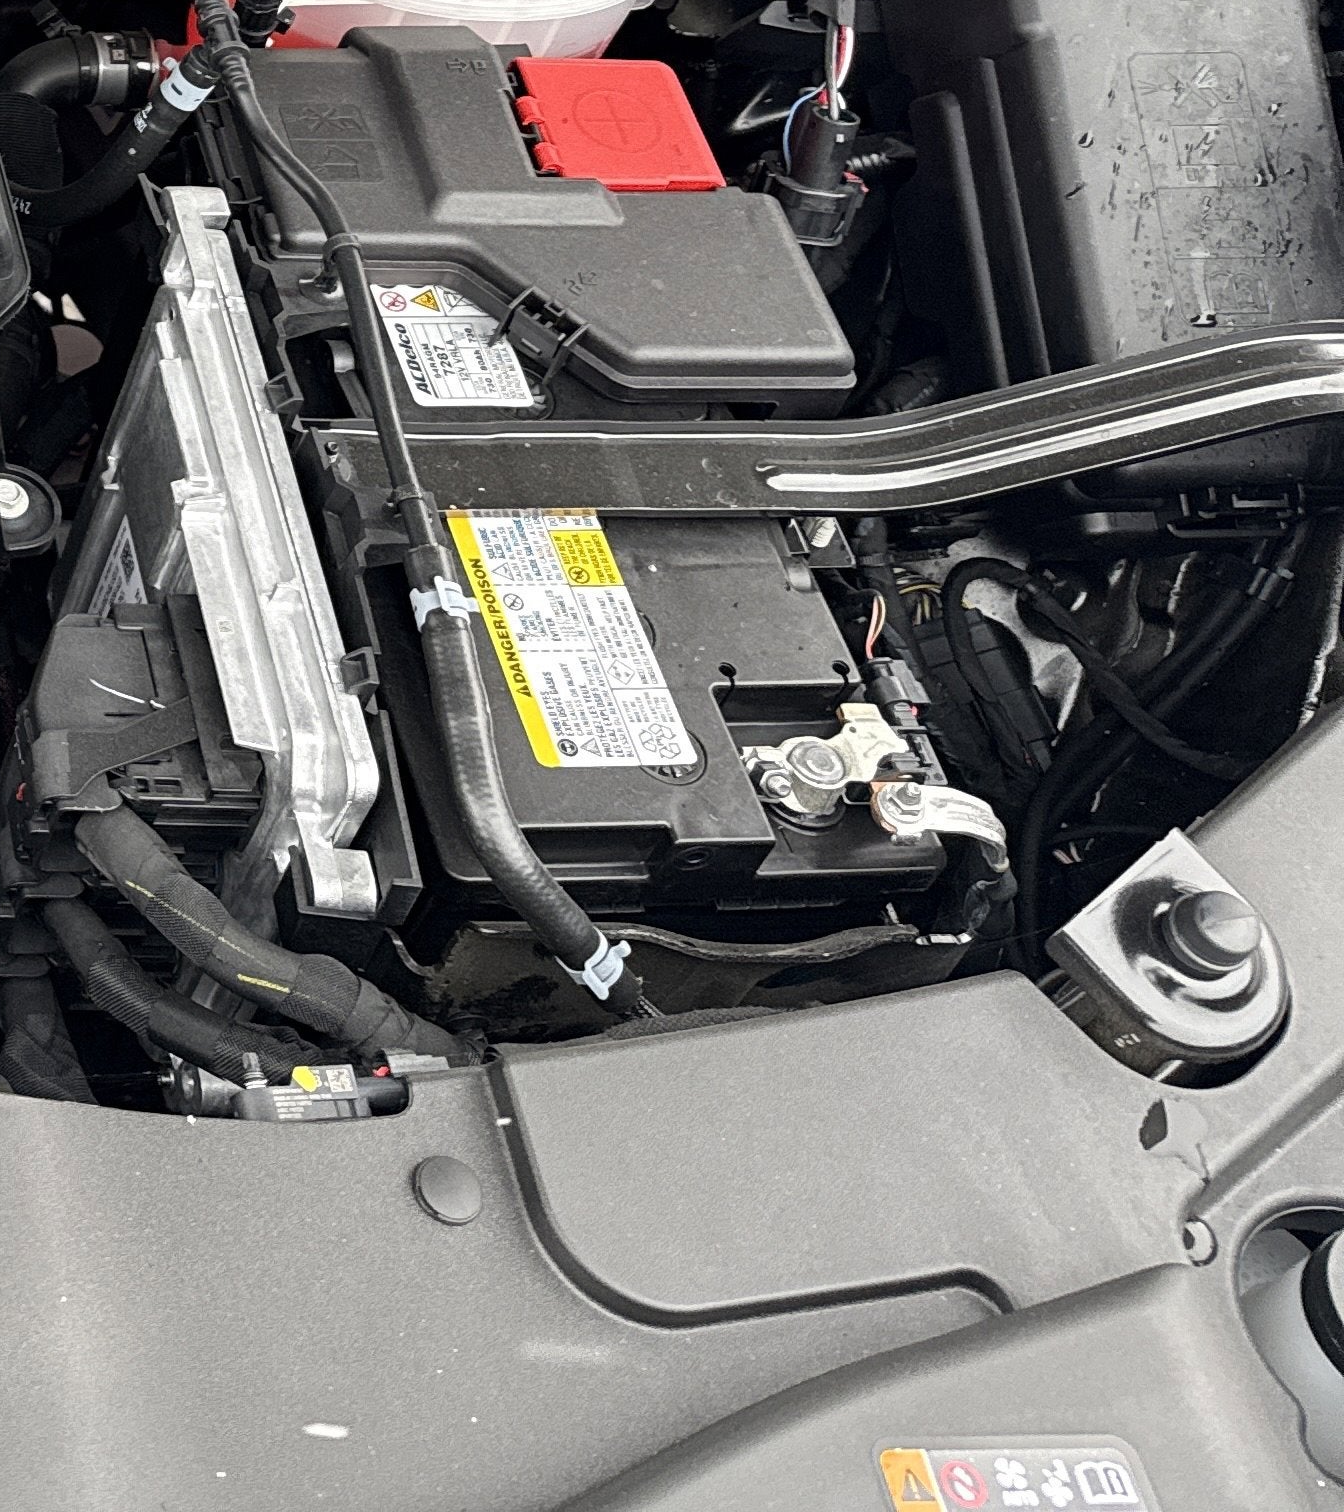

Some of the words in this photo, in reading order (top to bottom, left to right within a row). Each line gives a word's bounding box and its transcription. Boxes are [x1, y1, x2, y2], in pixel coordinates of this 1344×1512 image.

[394, 323, 432, 395] ACDelco
[432, 344, 456, 376] 7287
[444, 339, 463, 363] VRLA
[455, 366, 470, 381] 12V
[468, 557, 528, 683] DANGER/POISON
